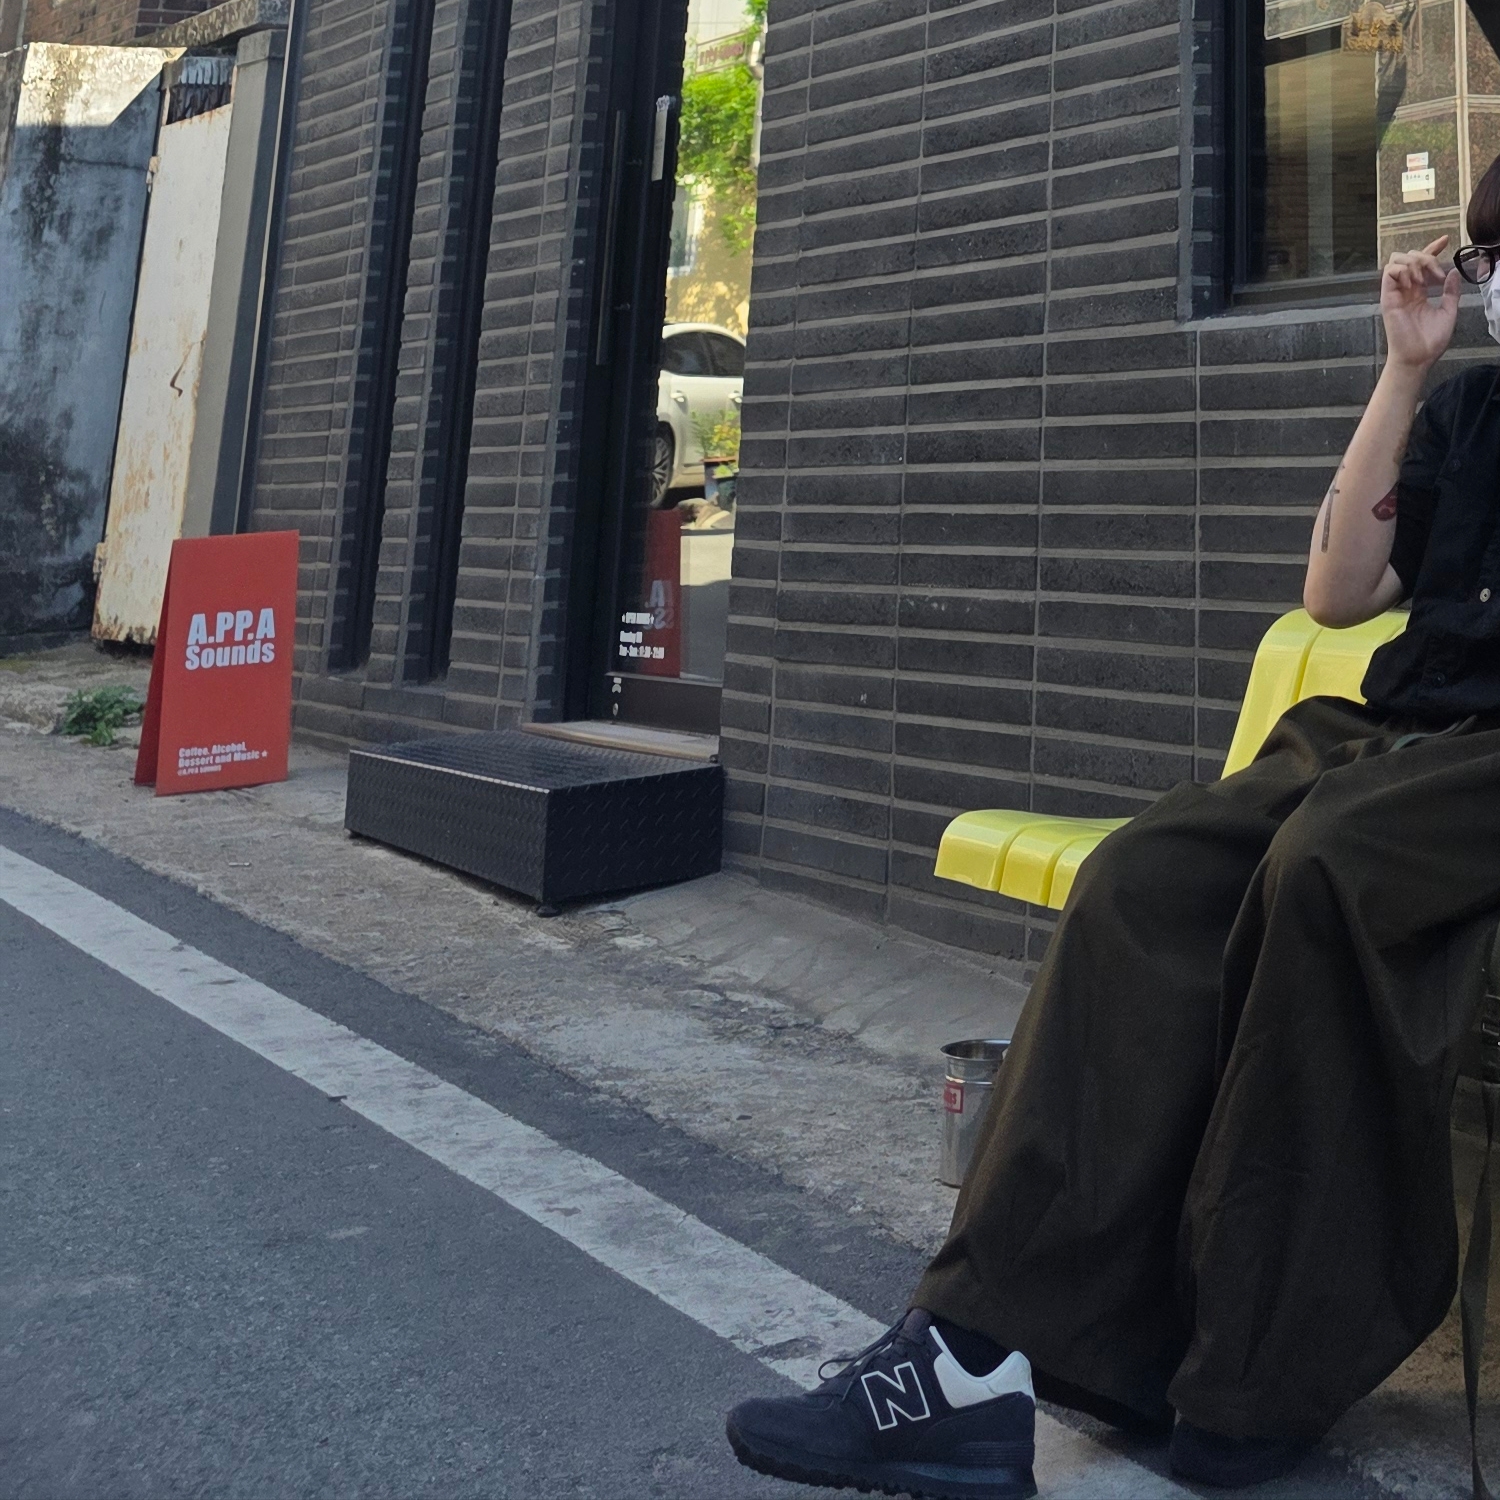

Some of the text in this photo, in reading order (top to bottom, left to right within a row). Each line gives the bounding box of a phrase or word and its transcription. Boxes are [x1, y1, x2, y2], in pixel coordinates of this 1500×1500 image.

[187, 607, 276, 645] A.PP.A
[185, 639, 276, 671] Sounds
[178, 749, 260, 768] Dessert and Music
[860, 1360, 932, 1431] N
